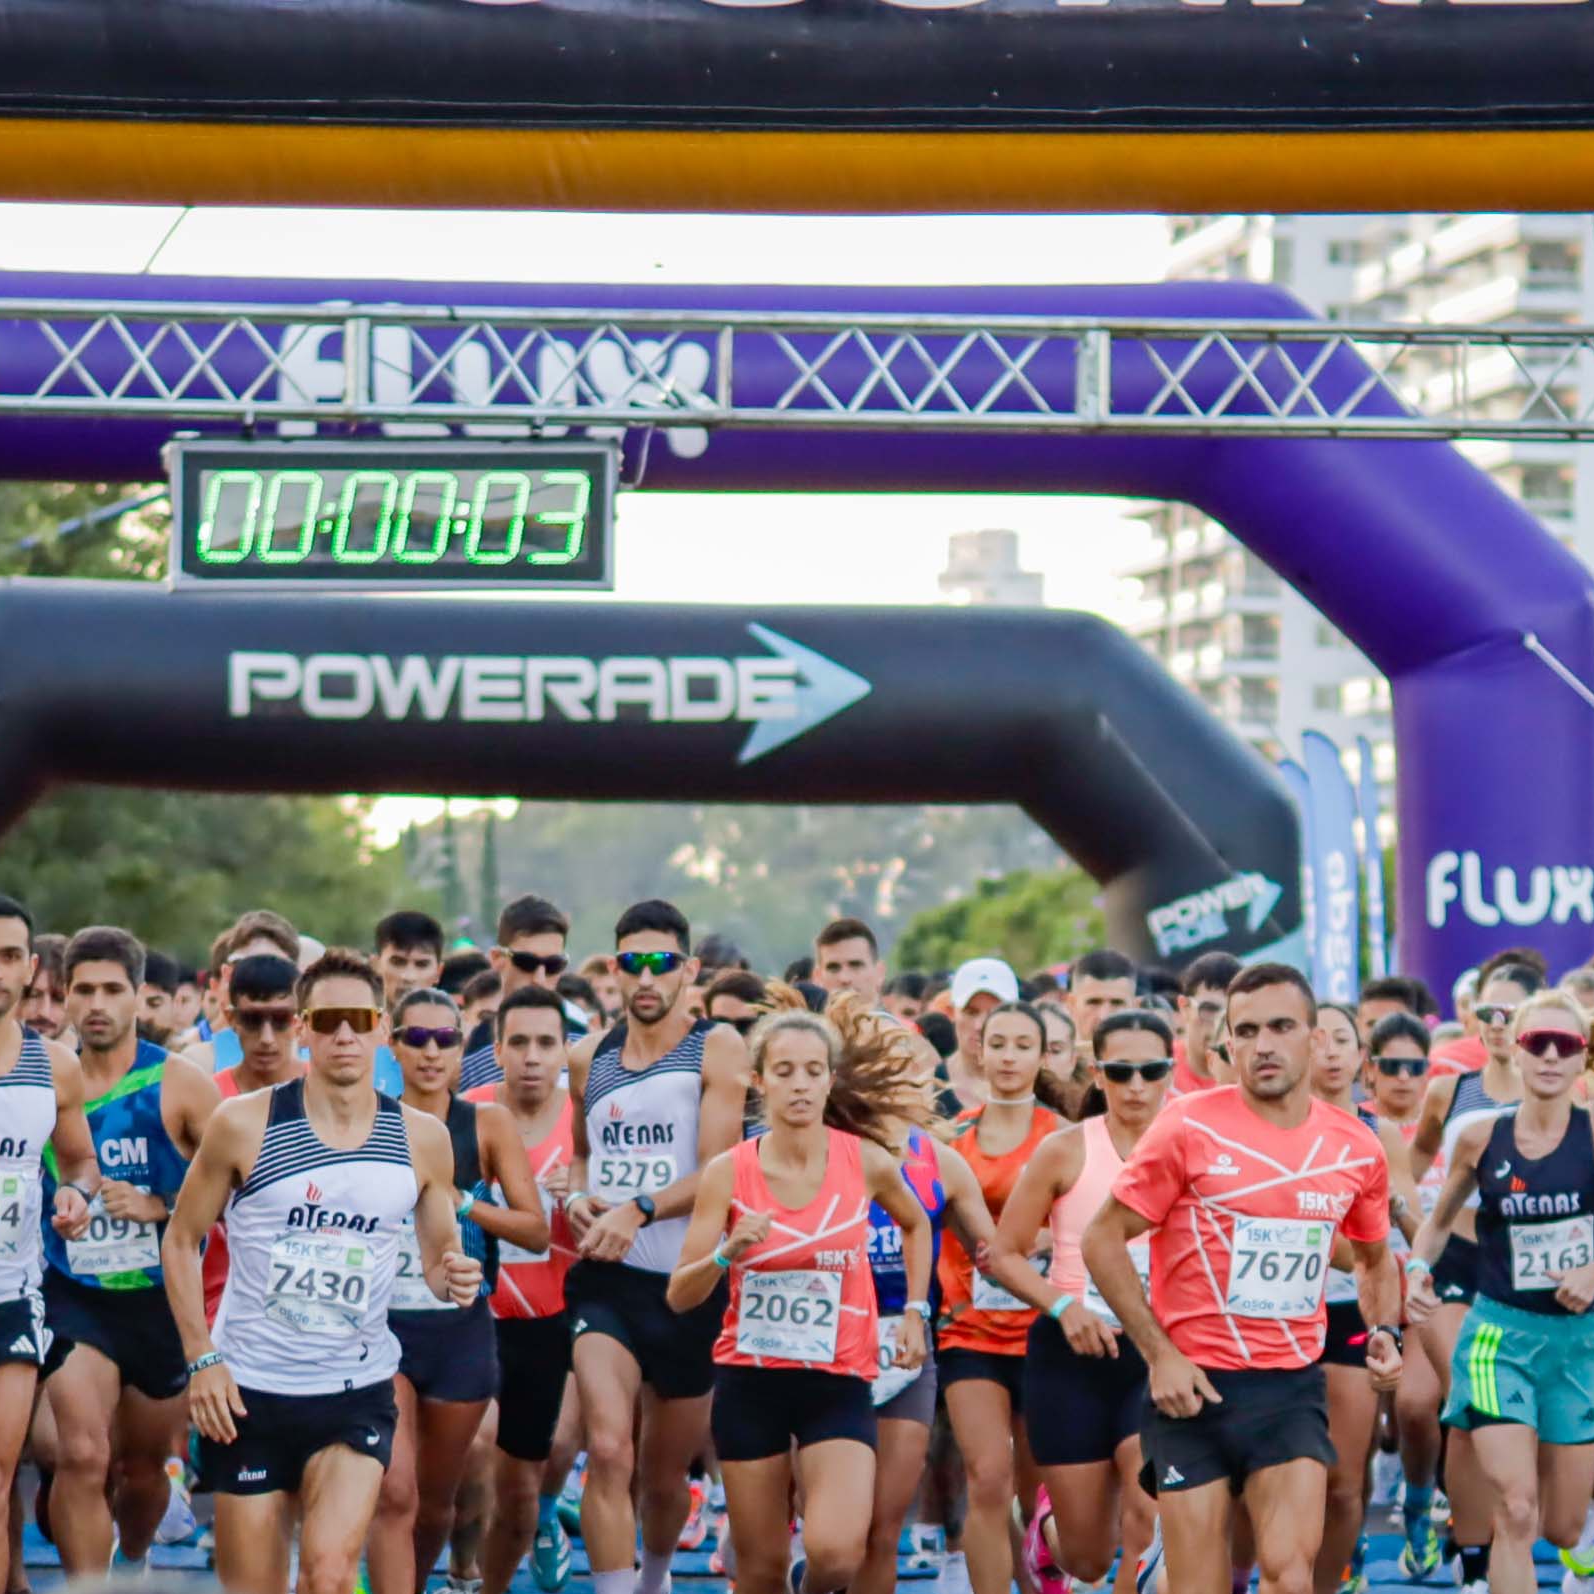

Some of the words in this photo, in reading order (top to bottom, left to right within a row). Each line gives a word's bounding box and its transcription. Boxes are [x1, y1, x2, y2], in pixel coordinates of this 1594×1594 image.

[198, 469, 591, 565] 00:00:03
[228, 651, 800, 723] POWERADE
[100, 1136, 149, 1168] CM
[599, 1159, 672, 1188] 5279
[286, 1202, 380, 1234] ATENAS
[1500, 1192, 1581, 1217] ATENAS
[1236, 1249, 1322, 1283] 7670
[1518, 1243, 1591, 1278] 2163
[272, 1262, 366, 1305] 7430
[743, 1292, 834, 1328] 2062
